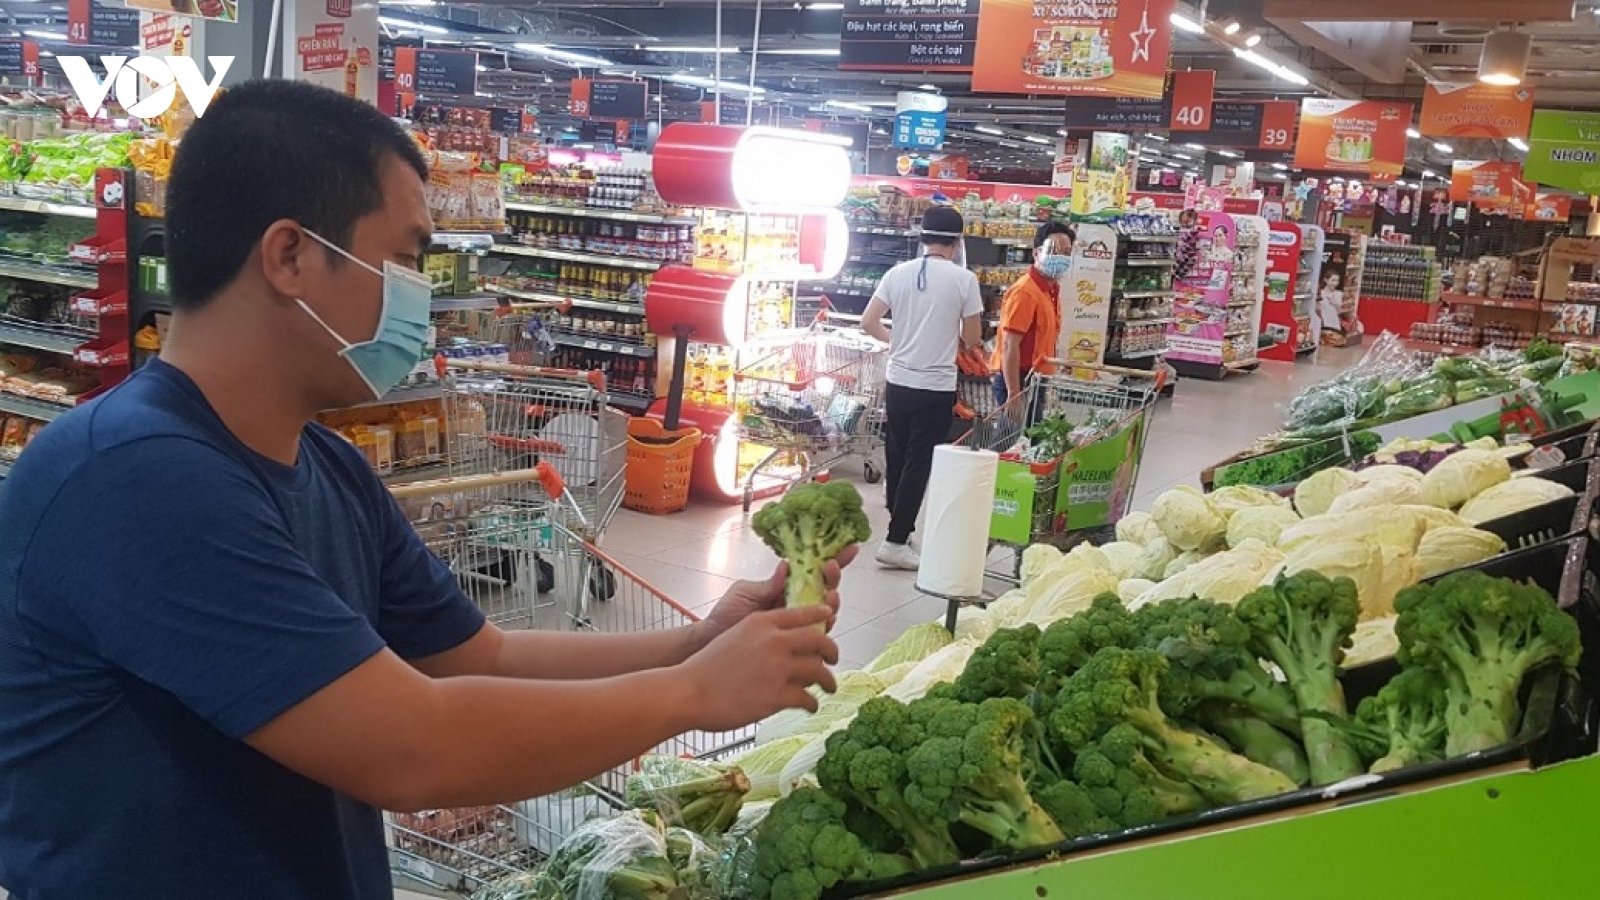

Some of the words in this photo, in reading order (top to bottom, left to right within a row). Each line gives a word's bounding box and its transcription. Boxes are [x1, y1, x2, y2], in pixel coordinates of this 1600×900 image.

[71, 22, 87, 40] 41
[882, 22, 898, 32] các
[920, 22, 942, 33] rong
[928, 45, 943, 55] các
[945, 44, 962, 56] loại
[25, 61, 37, 74] 26
[398, 73, 413, 88] 40
[573, 101, 587, 113] 39
[1176, 106, 1204, 126] 40
[1263, 129, 1288, 146] 39
[1552, 146, 1597, 163] NHÓM
